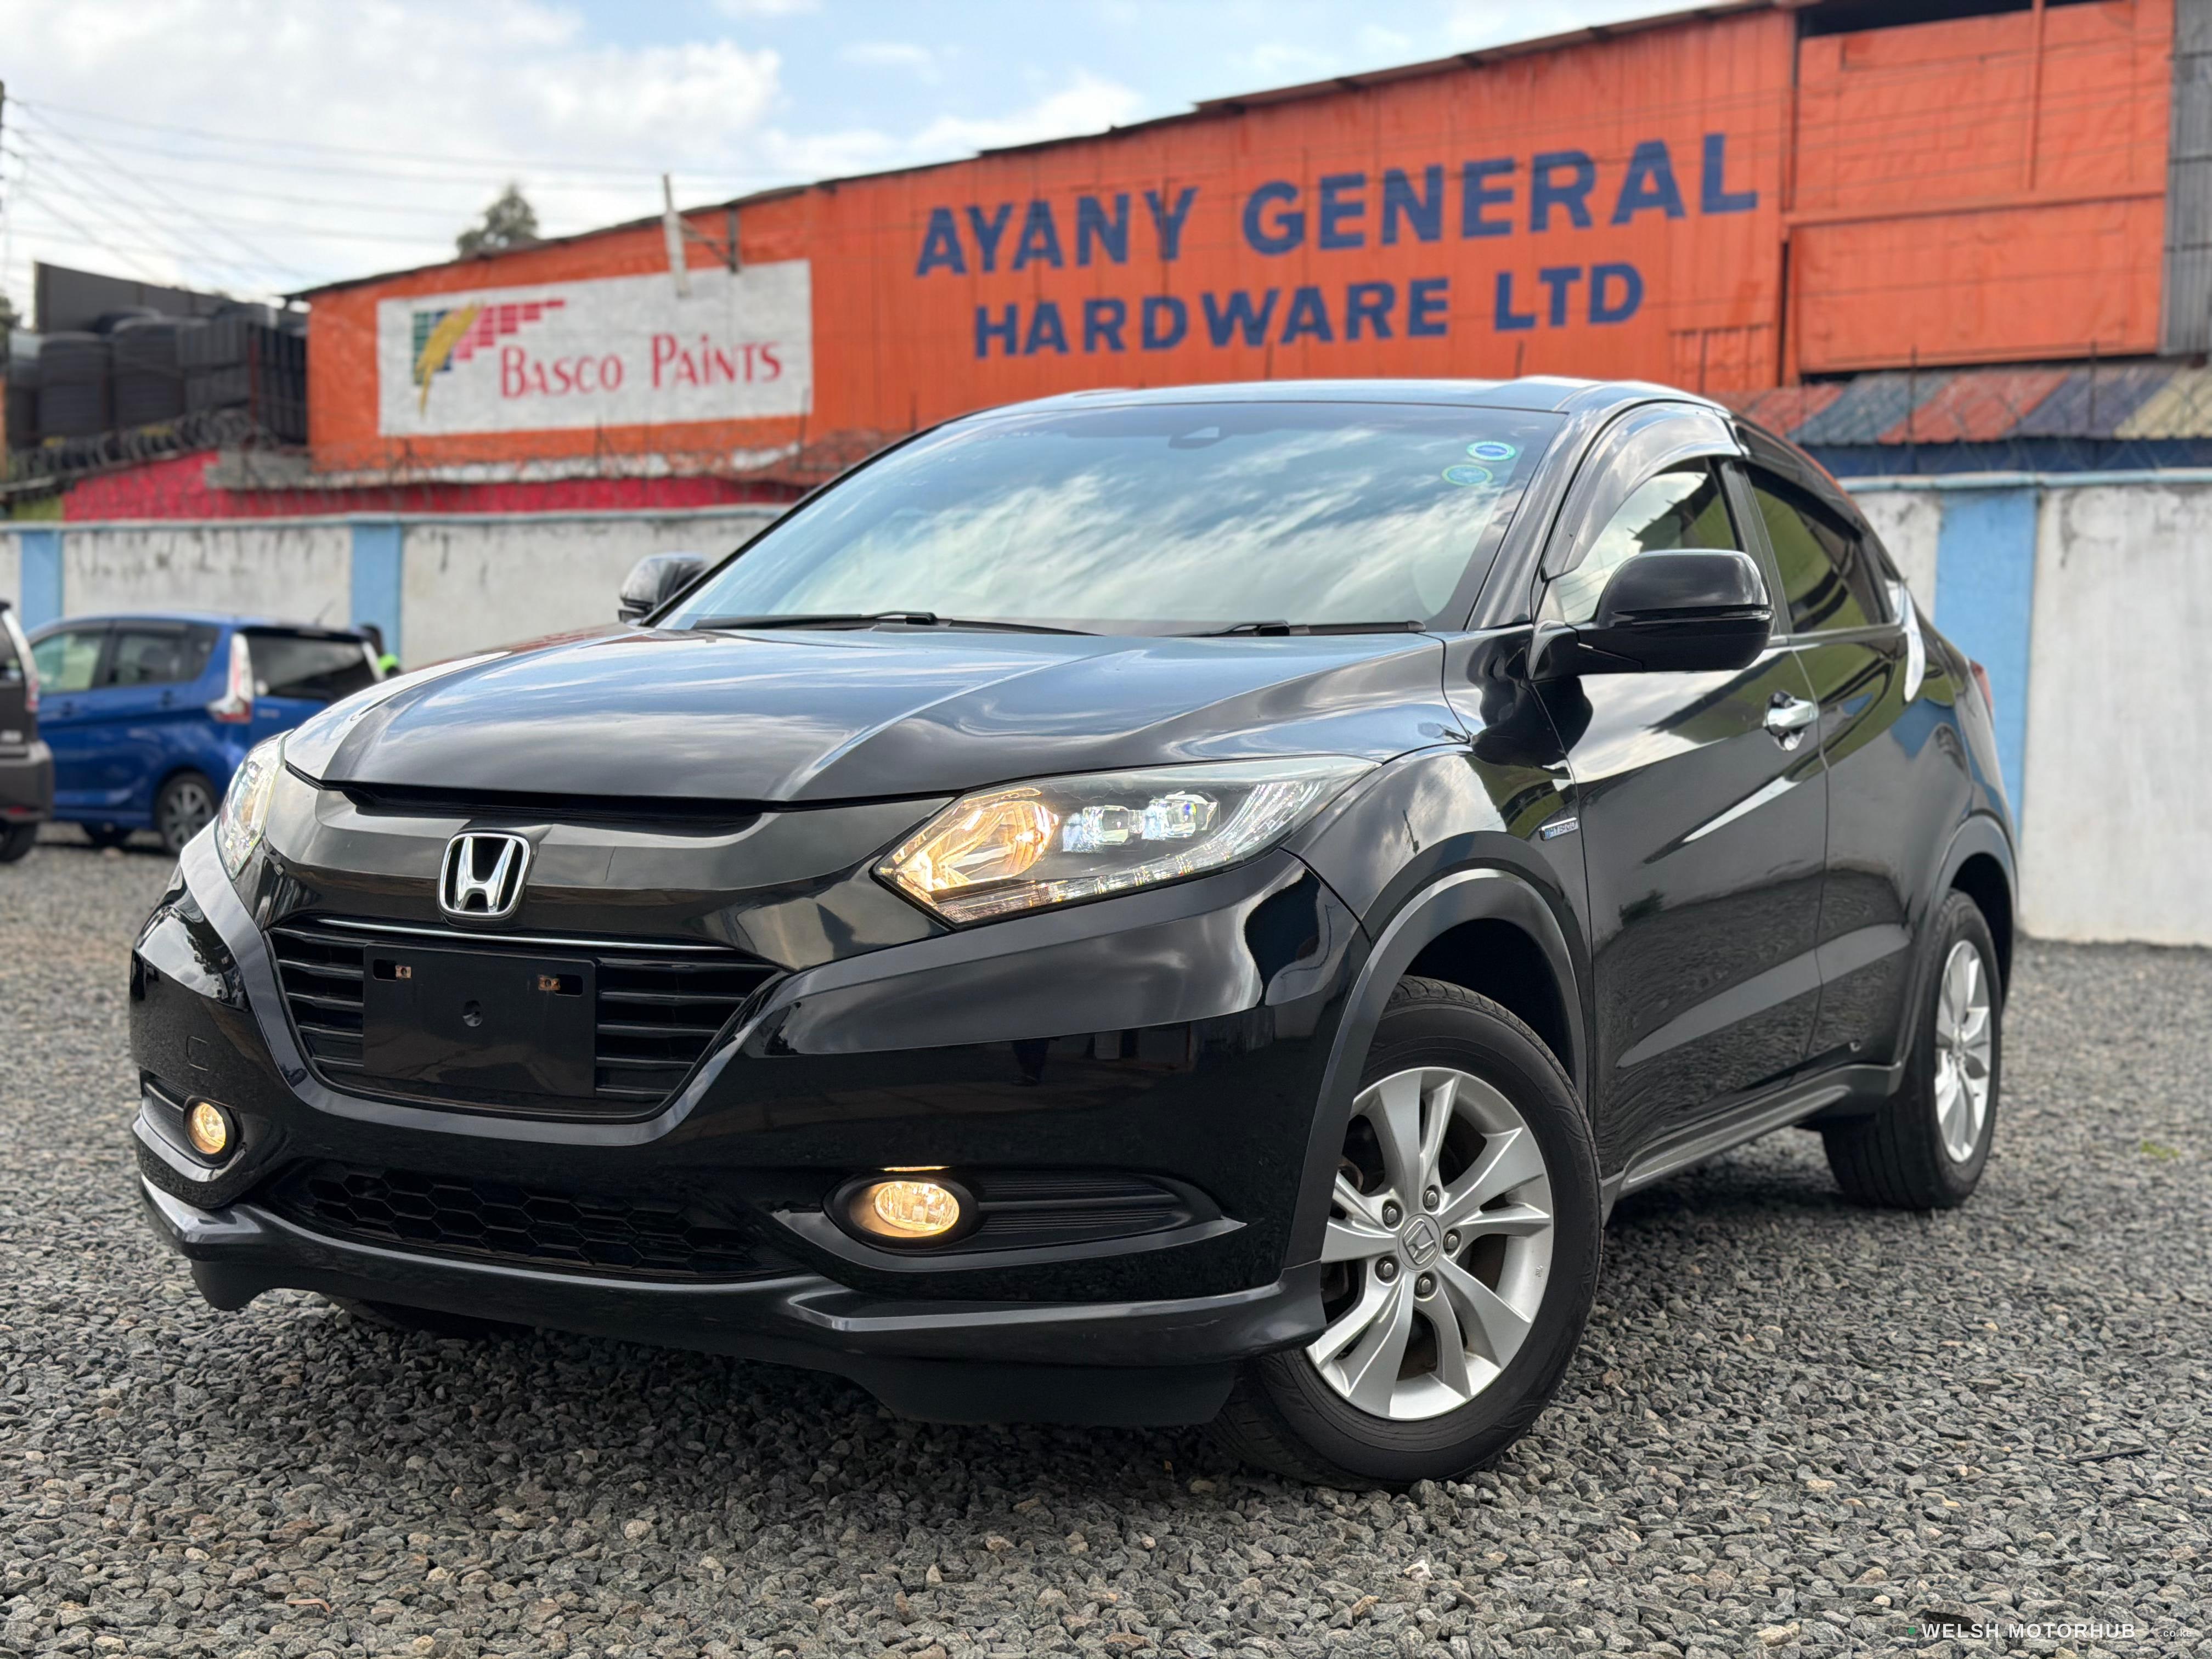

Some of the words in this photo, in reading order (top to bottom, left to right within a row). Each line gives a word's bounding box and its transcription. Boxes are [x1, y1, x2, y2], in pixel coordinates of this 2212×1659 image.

[915, 187, 1199, 276] AYANY
[1242, 133, 1759, 256] GENERAL
[975, 279, 1449, 359] HARDWARE
[1494, 263, 1645, 332] LTD
[501, 345, 623, 399] BASCO
